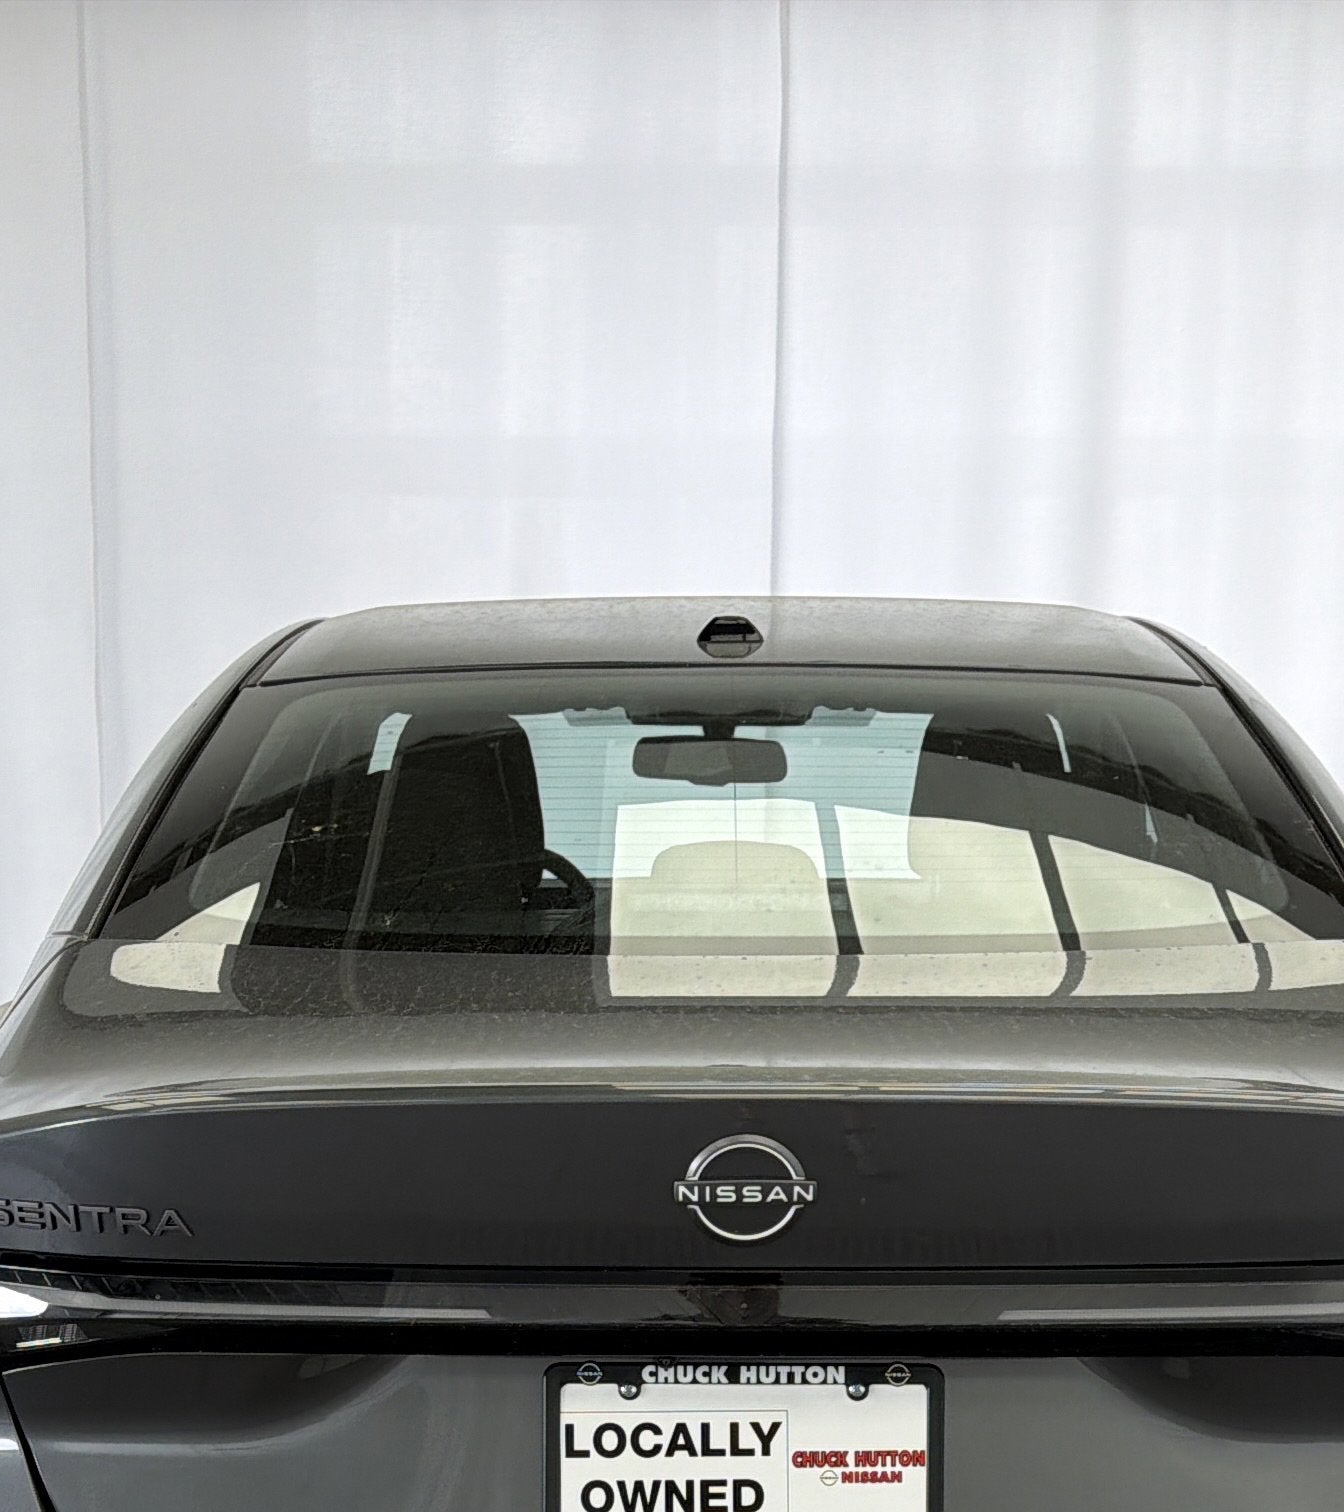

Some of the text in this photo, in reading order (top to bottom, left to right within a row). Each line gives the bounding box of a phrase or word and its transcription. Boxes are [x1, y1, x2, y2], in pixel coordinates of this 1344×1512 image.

[678, 1185, 814, 1203] NISSAN
[641, 1365, 846, 1384] CHUCK HUTTON
[564, 1422, 783, 1458] LOCALLY
[792, 1450, 926, 1468] CHUCK HUTTON
[841, 1471, 903, 1484] NISSAN
